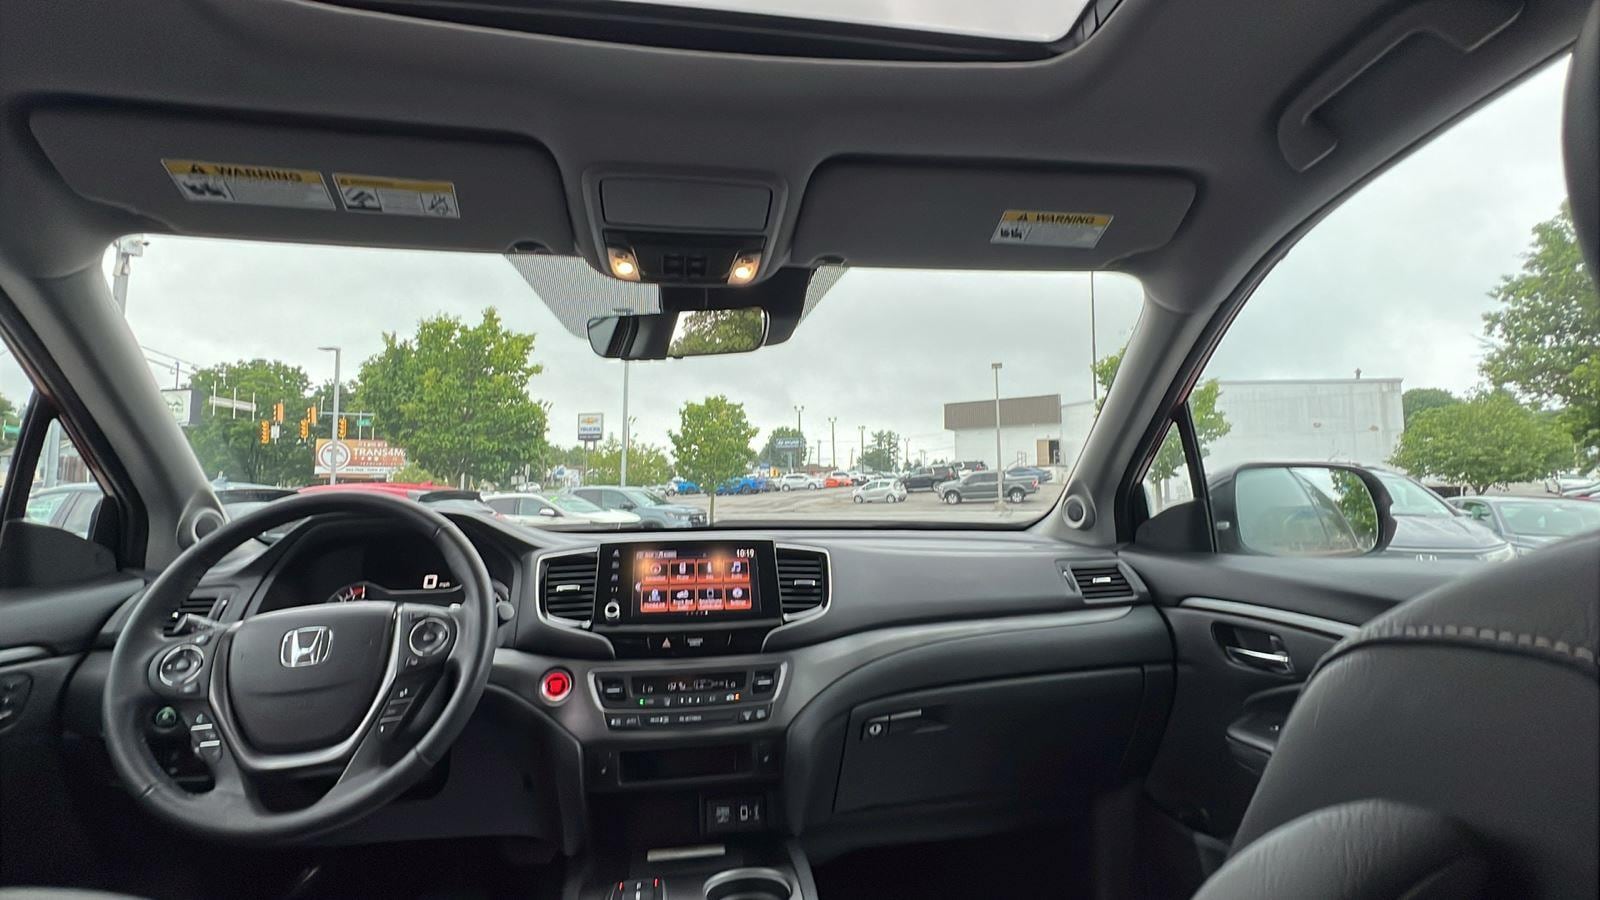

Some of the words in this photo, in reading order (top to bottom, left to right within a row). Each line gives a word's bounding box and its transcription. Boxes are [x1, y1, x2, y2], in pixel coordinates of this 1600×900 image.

[213, 165, 303, 182] WARNING
[1035, 212, 1096, 224] WARNING
[736, 548, 755, 558] 10:19
[423, 574, 438, 589] 0
